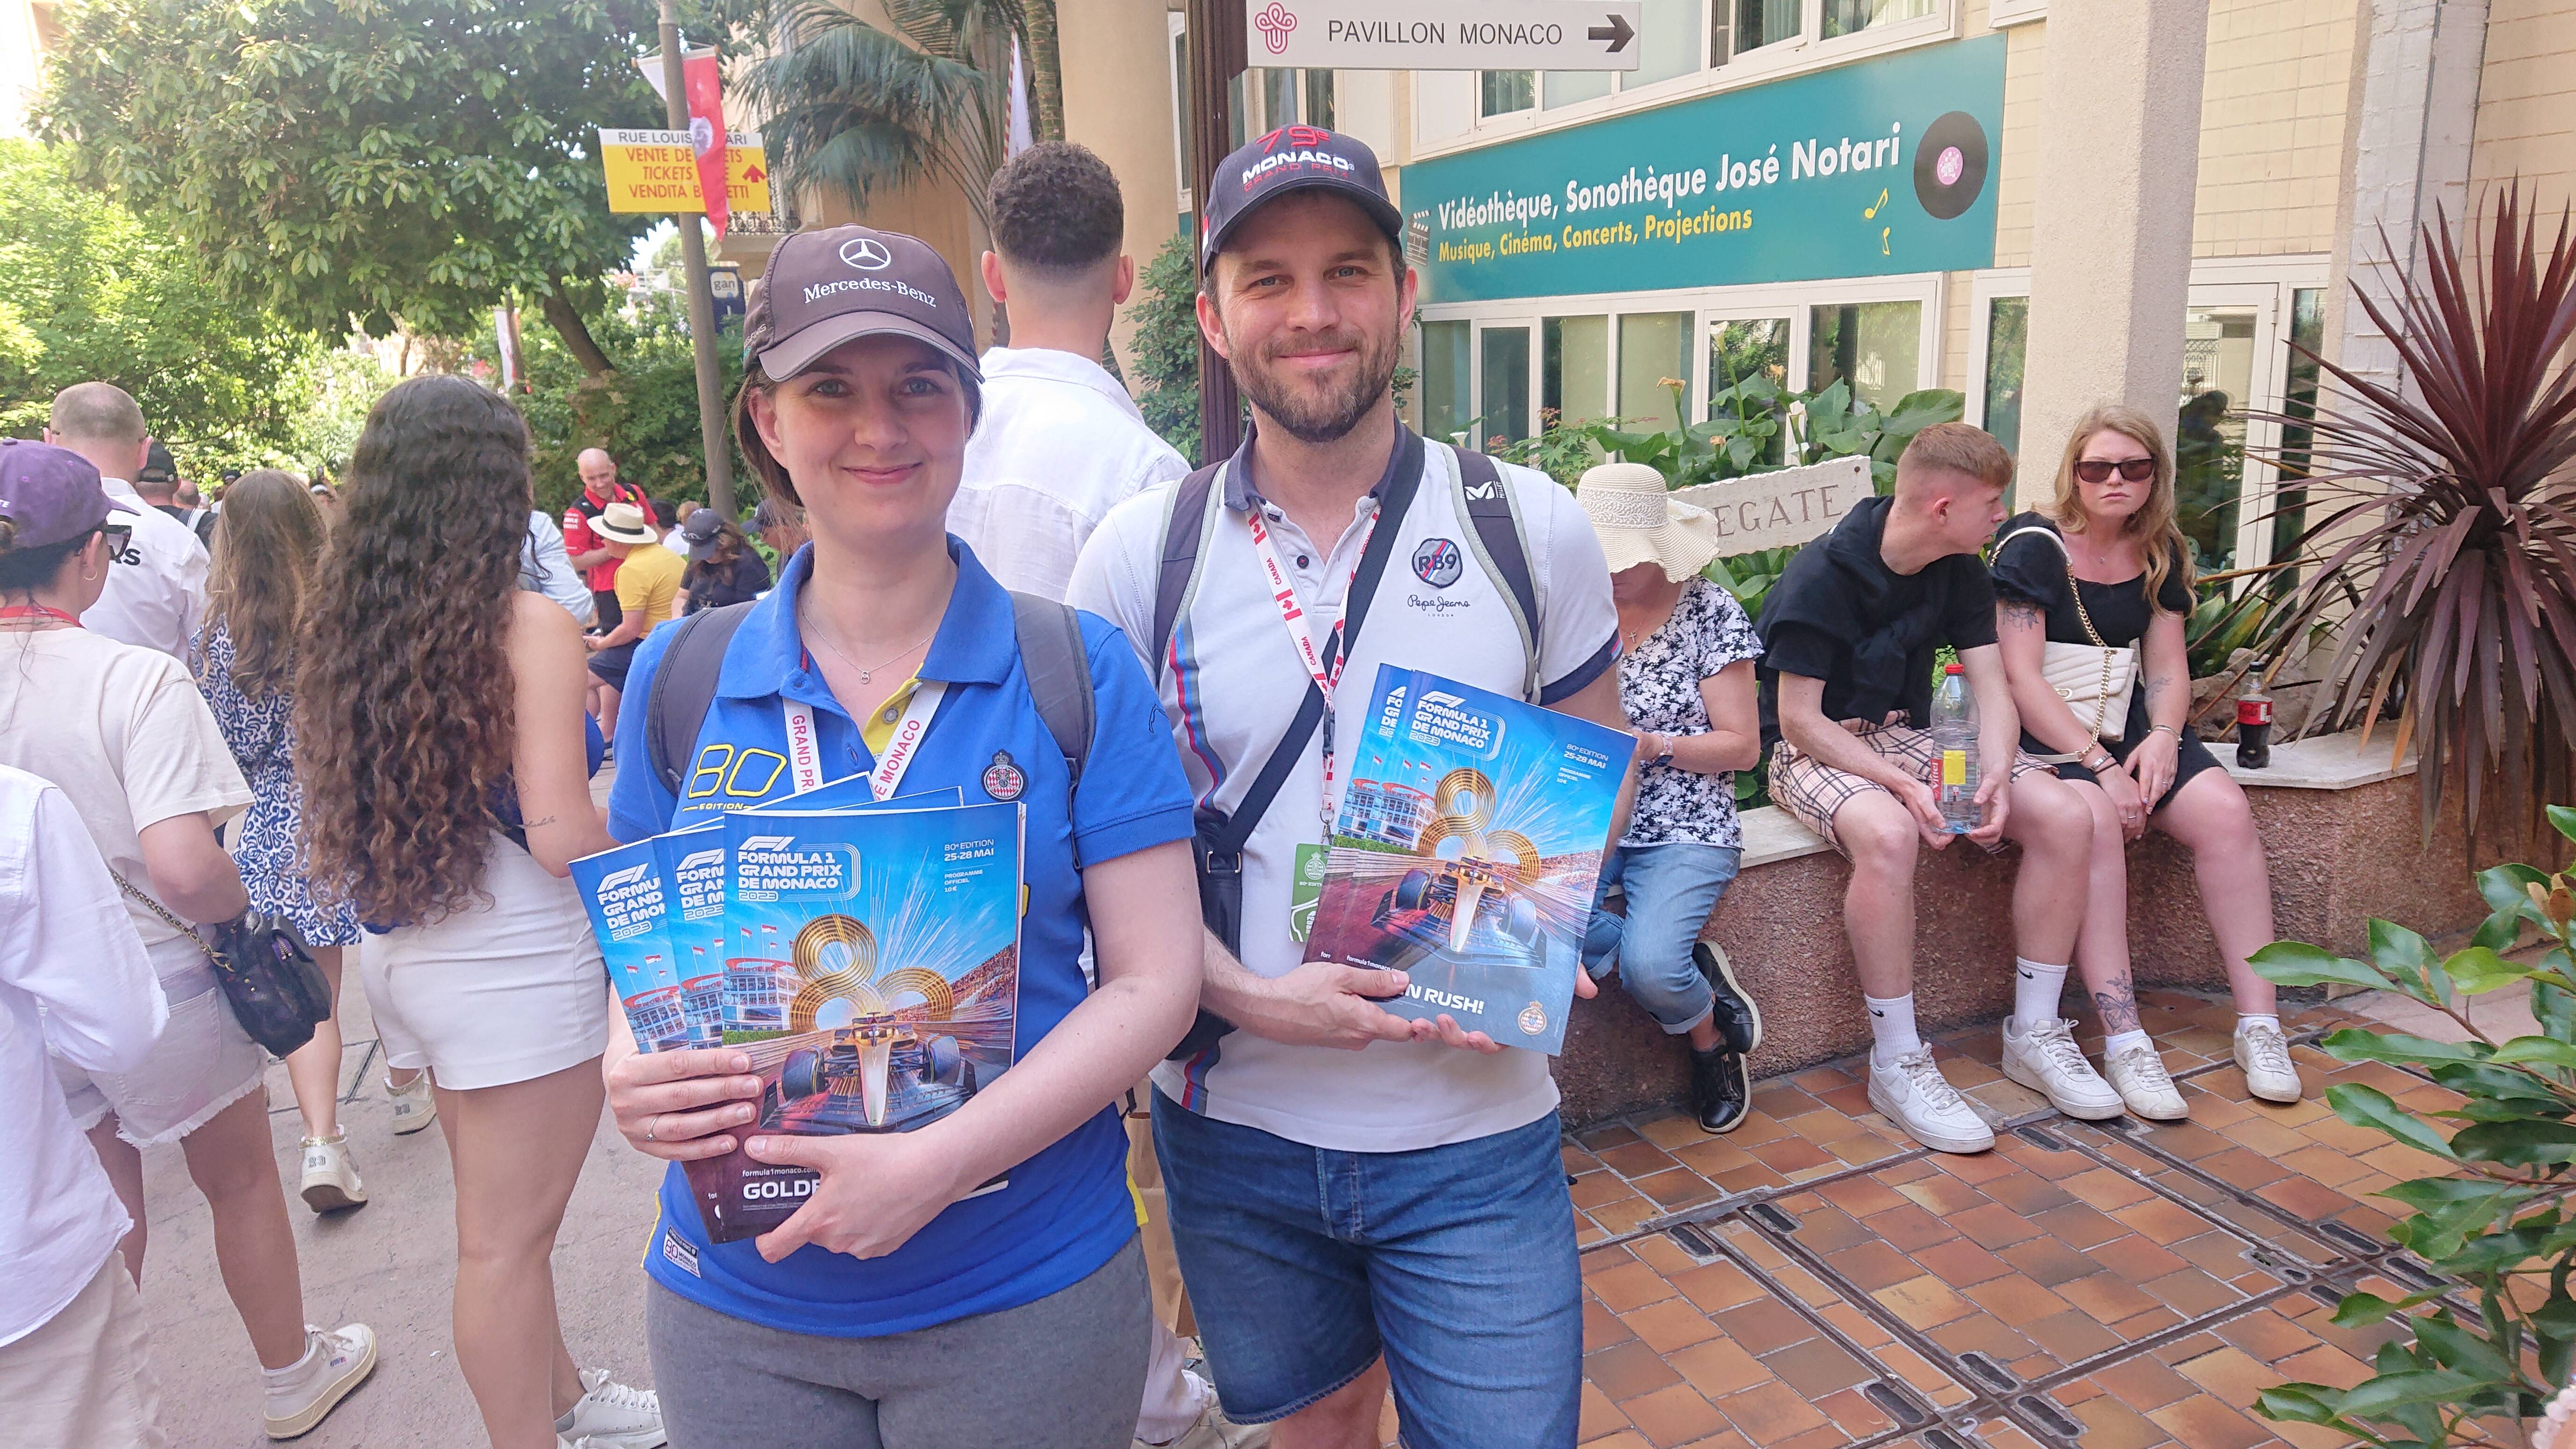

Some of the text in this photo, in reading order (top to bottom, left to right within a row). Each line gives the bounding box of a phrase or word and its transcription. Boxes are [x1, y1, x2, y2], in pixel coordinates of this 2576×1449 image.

[1328, 19, 1563, 45] PAVILLON MONACO
[619, 132, 747, 145] RUE LOUIS ARI
[626, 148, 692, 162] VENTE DE
[643, 166, 693, 181] TICKETS
[1243, 162, 1350, 192] GRAND PRIX
[1438, 121, 1901, 230] Vidéothèque, Sonothèque José Notari
[629, 184, 688, 198] VENDITA
[1438, 205, 1752, 264] Musique, Cinéma, Concerts, Projections
[714, 279, 735, 291] gan
[803, 278, 937, 308] Mercedes-Benz
[1712, 483, 1843, 561] EGATE
[1266, 557, 1282, 585] CANADA
[1419, 553, 1456, 571] RB9
[1407, 594, 1471, 612] Pepe Jeans
[1301, 636, 1317, 666] CANADA
[1417, 700, 1479, 726] FORMULA
[1479, 718, 1488, 729] 1
[1411, 719, 1485, 749] DE MONACO
[1415, 710, 1460, 731] GRAND
[1460, 724, 1492, 741] PRIX
[1409, 730, 1441, 746] 2023
[792, 715, 814, 791] GRAND PR
[879, 719, 920, 783] MONACO
[1579, 747, 1609, 761] EDITION
[688, 743, 788, 799] 80
[1587, 758, 1607, 769] MAI
[960, 838, 994, 849] EDITION
[974, 848, 994, 858] MAI
[738, 850, 835, 865] FORMULA 1
[738, 864, 843, 877] GRAND PRIX
[944, 869, 983, 879] PROGRAMME
[597, 877, 661, 906] FORMU
[679, 878, 724, 895] GRAN
[738, 877, 839, 890] DE MONACO
[603, 891, 663, 917] GRAND
[681, 894, 705, 909] DE
[739, 890, 778, 901] 2023
[606, 914, 630, 929] DE
[611, 921, 652, 942] 2023
[1423, 987, 1486, 1015] RUSH!
[743, 1179, 820, 1200] GOLD
[665, 1239, 678, 1259] 80
